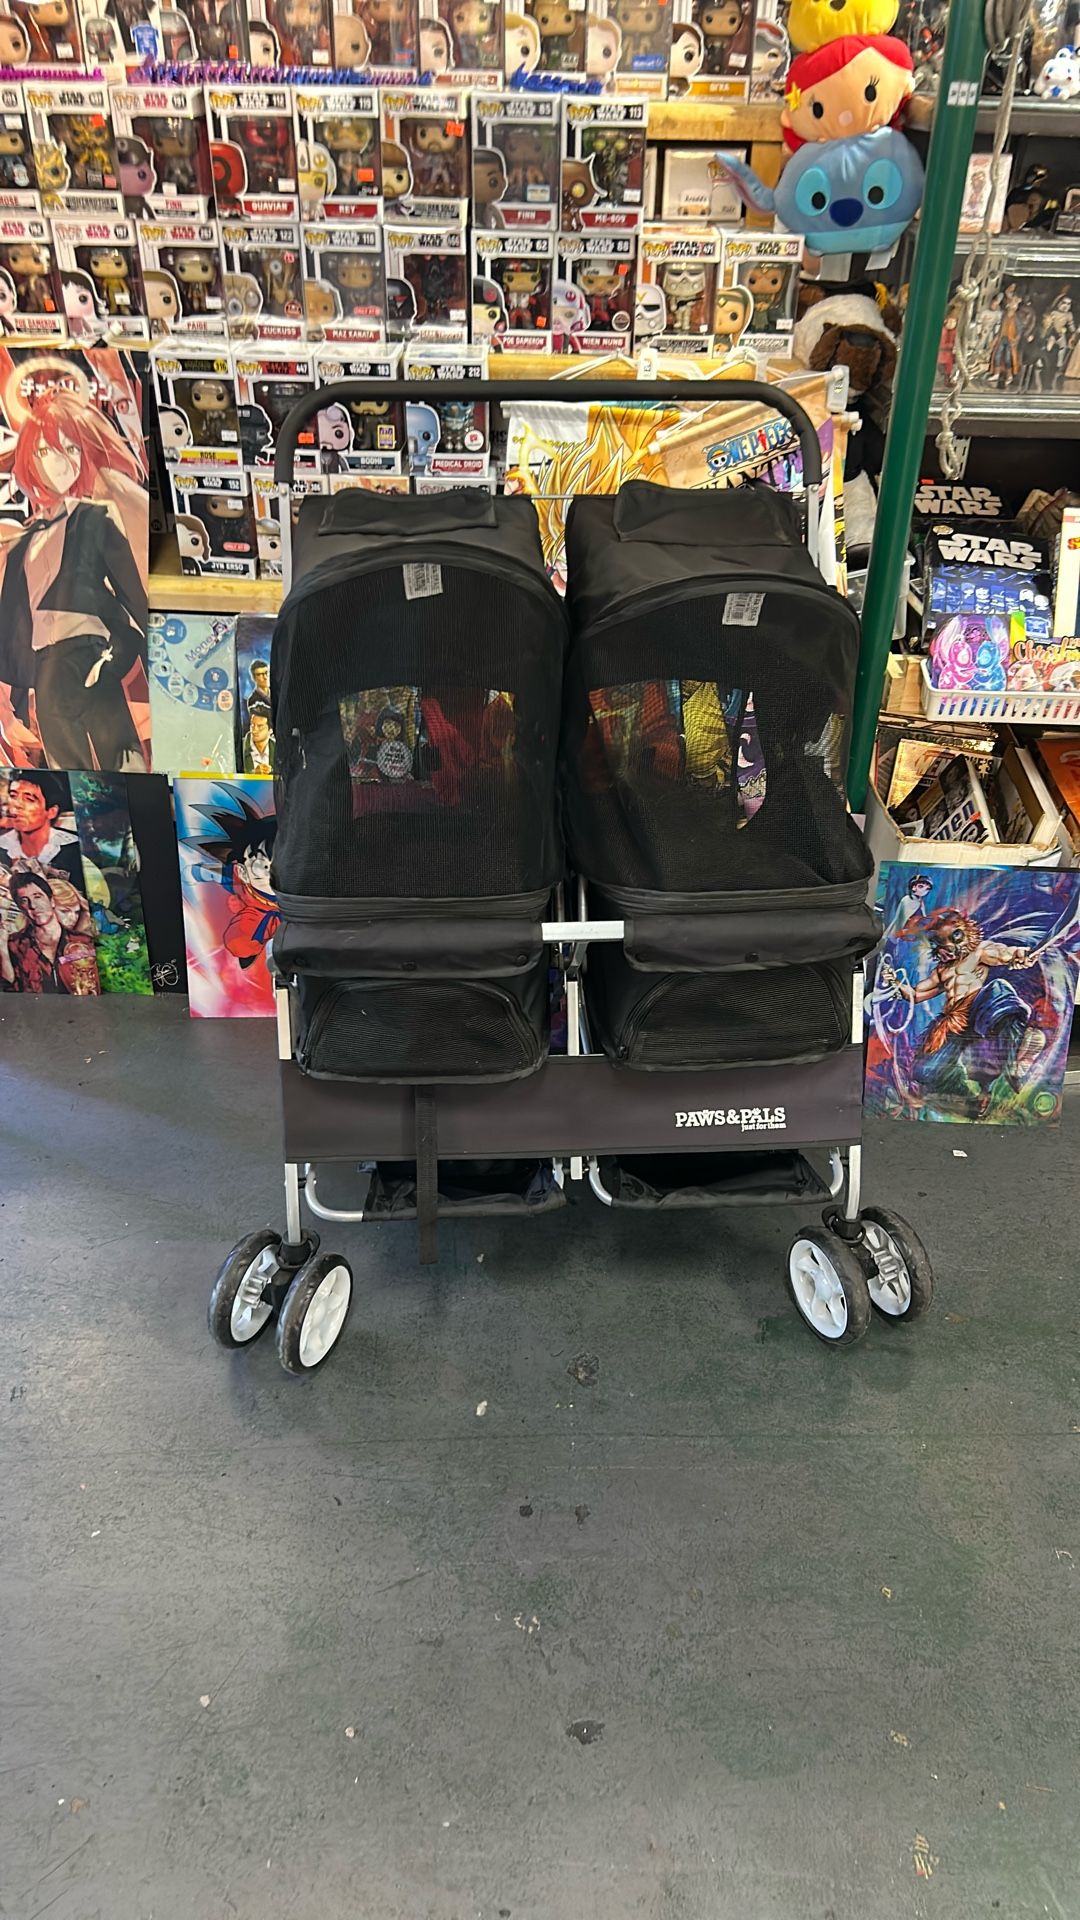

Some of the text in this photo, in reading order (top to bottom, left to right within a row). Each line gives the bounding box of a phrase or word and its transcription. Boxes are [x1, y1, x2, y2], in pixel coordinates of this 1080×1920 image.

[339, 205, 356, 214] REY
[468, 366, 481, 378] 212
[434, 460, 482, 469] MEDICAL DROID
[915, 485, 1001, 500] STAR
[914, 499, 1002, 516] WARS
[938, 533, 1042, 558] STAR
[938, 545, 1042, 570] WARS
[741, 1123, 755, 1132] just
[767, 1122, 786, 1130] them
